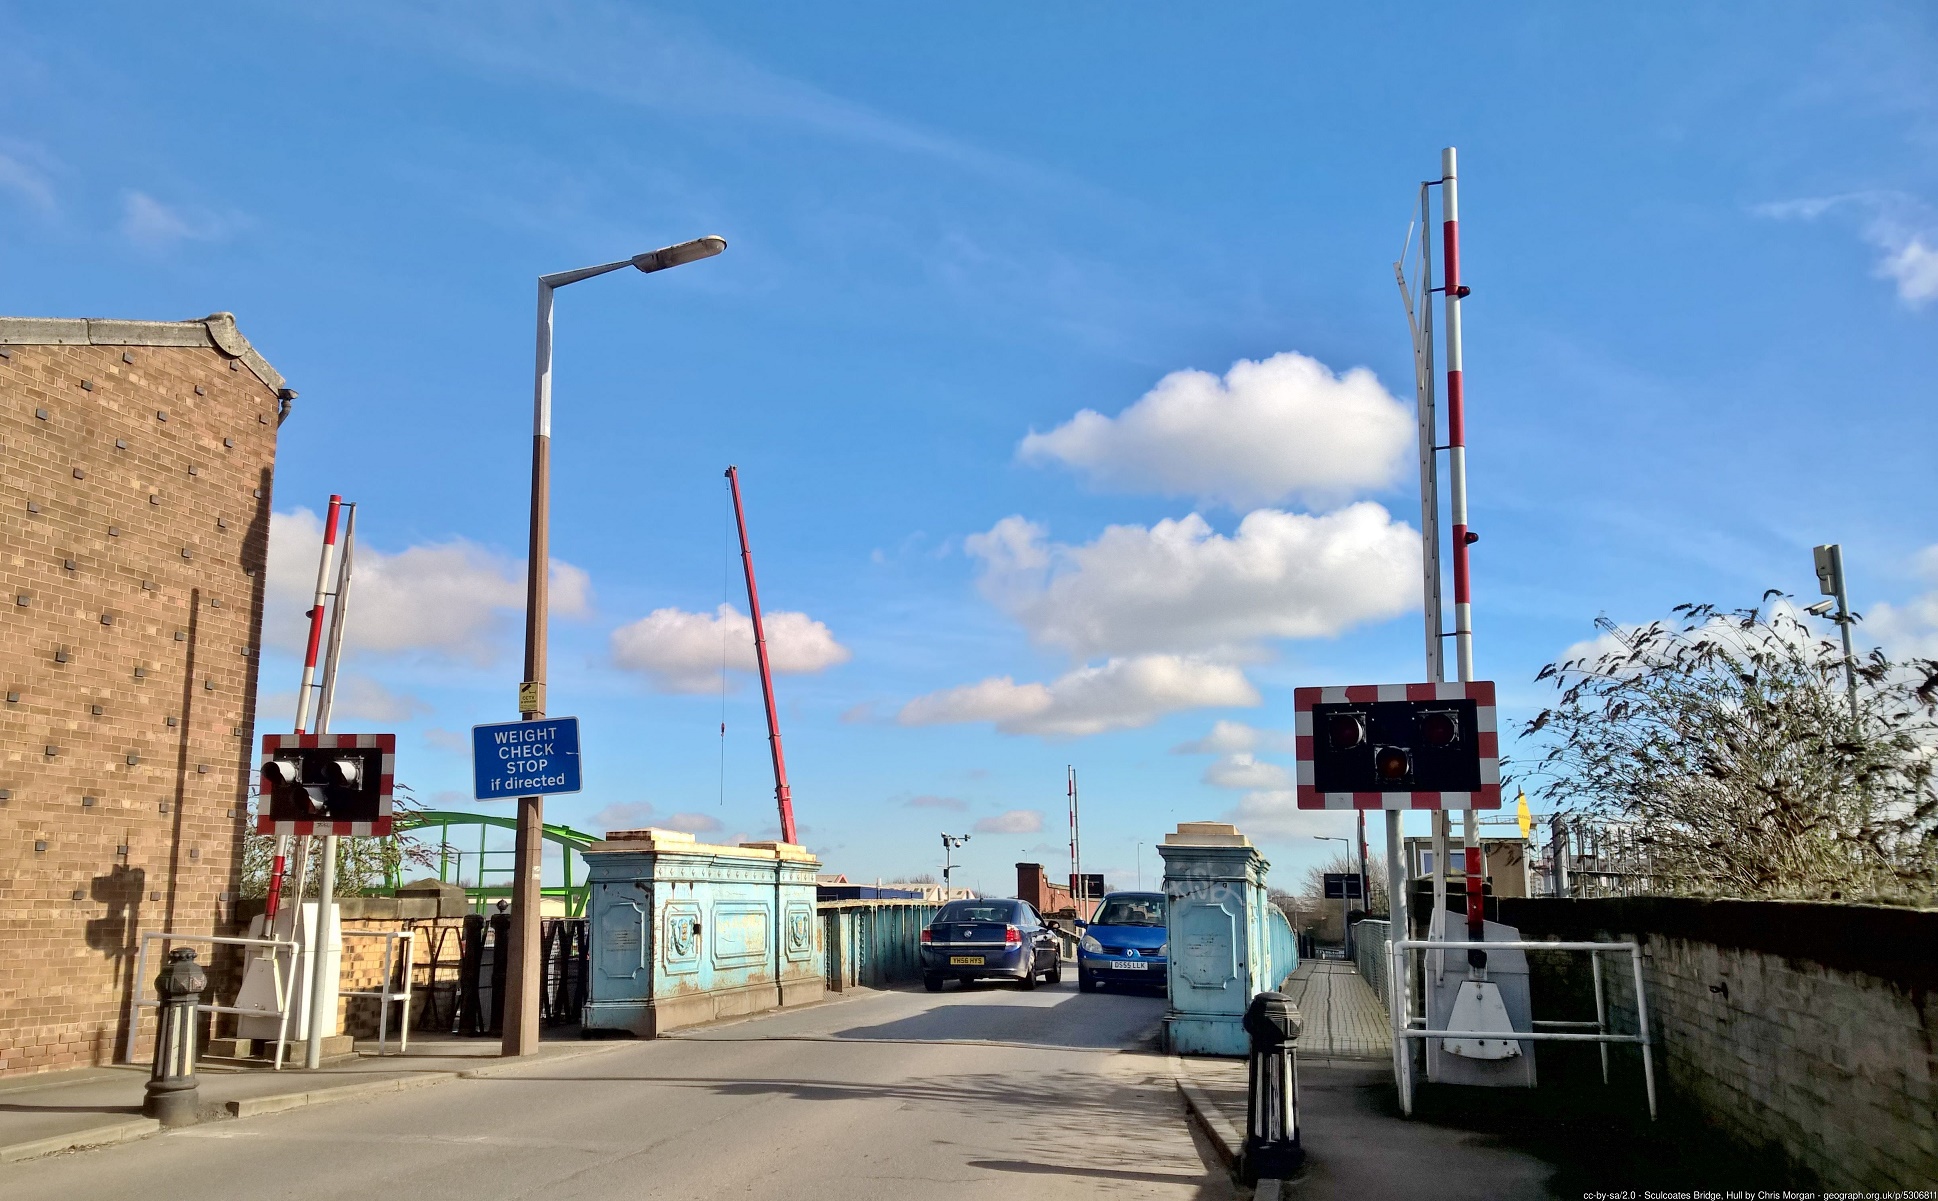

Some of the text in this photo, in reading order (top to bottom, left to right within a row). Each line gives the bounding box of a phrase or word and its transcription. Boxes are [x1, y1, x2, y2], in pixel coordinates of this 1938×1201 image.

[494, 727, 557, 744] WEIGHT
[498, 743, 554, 759] CHECK
[506, 759, 548, 774] STOP
[491, 772, 565, 791] if directed
